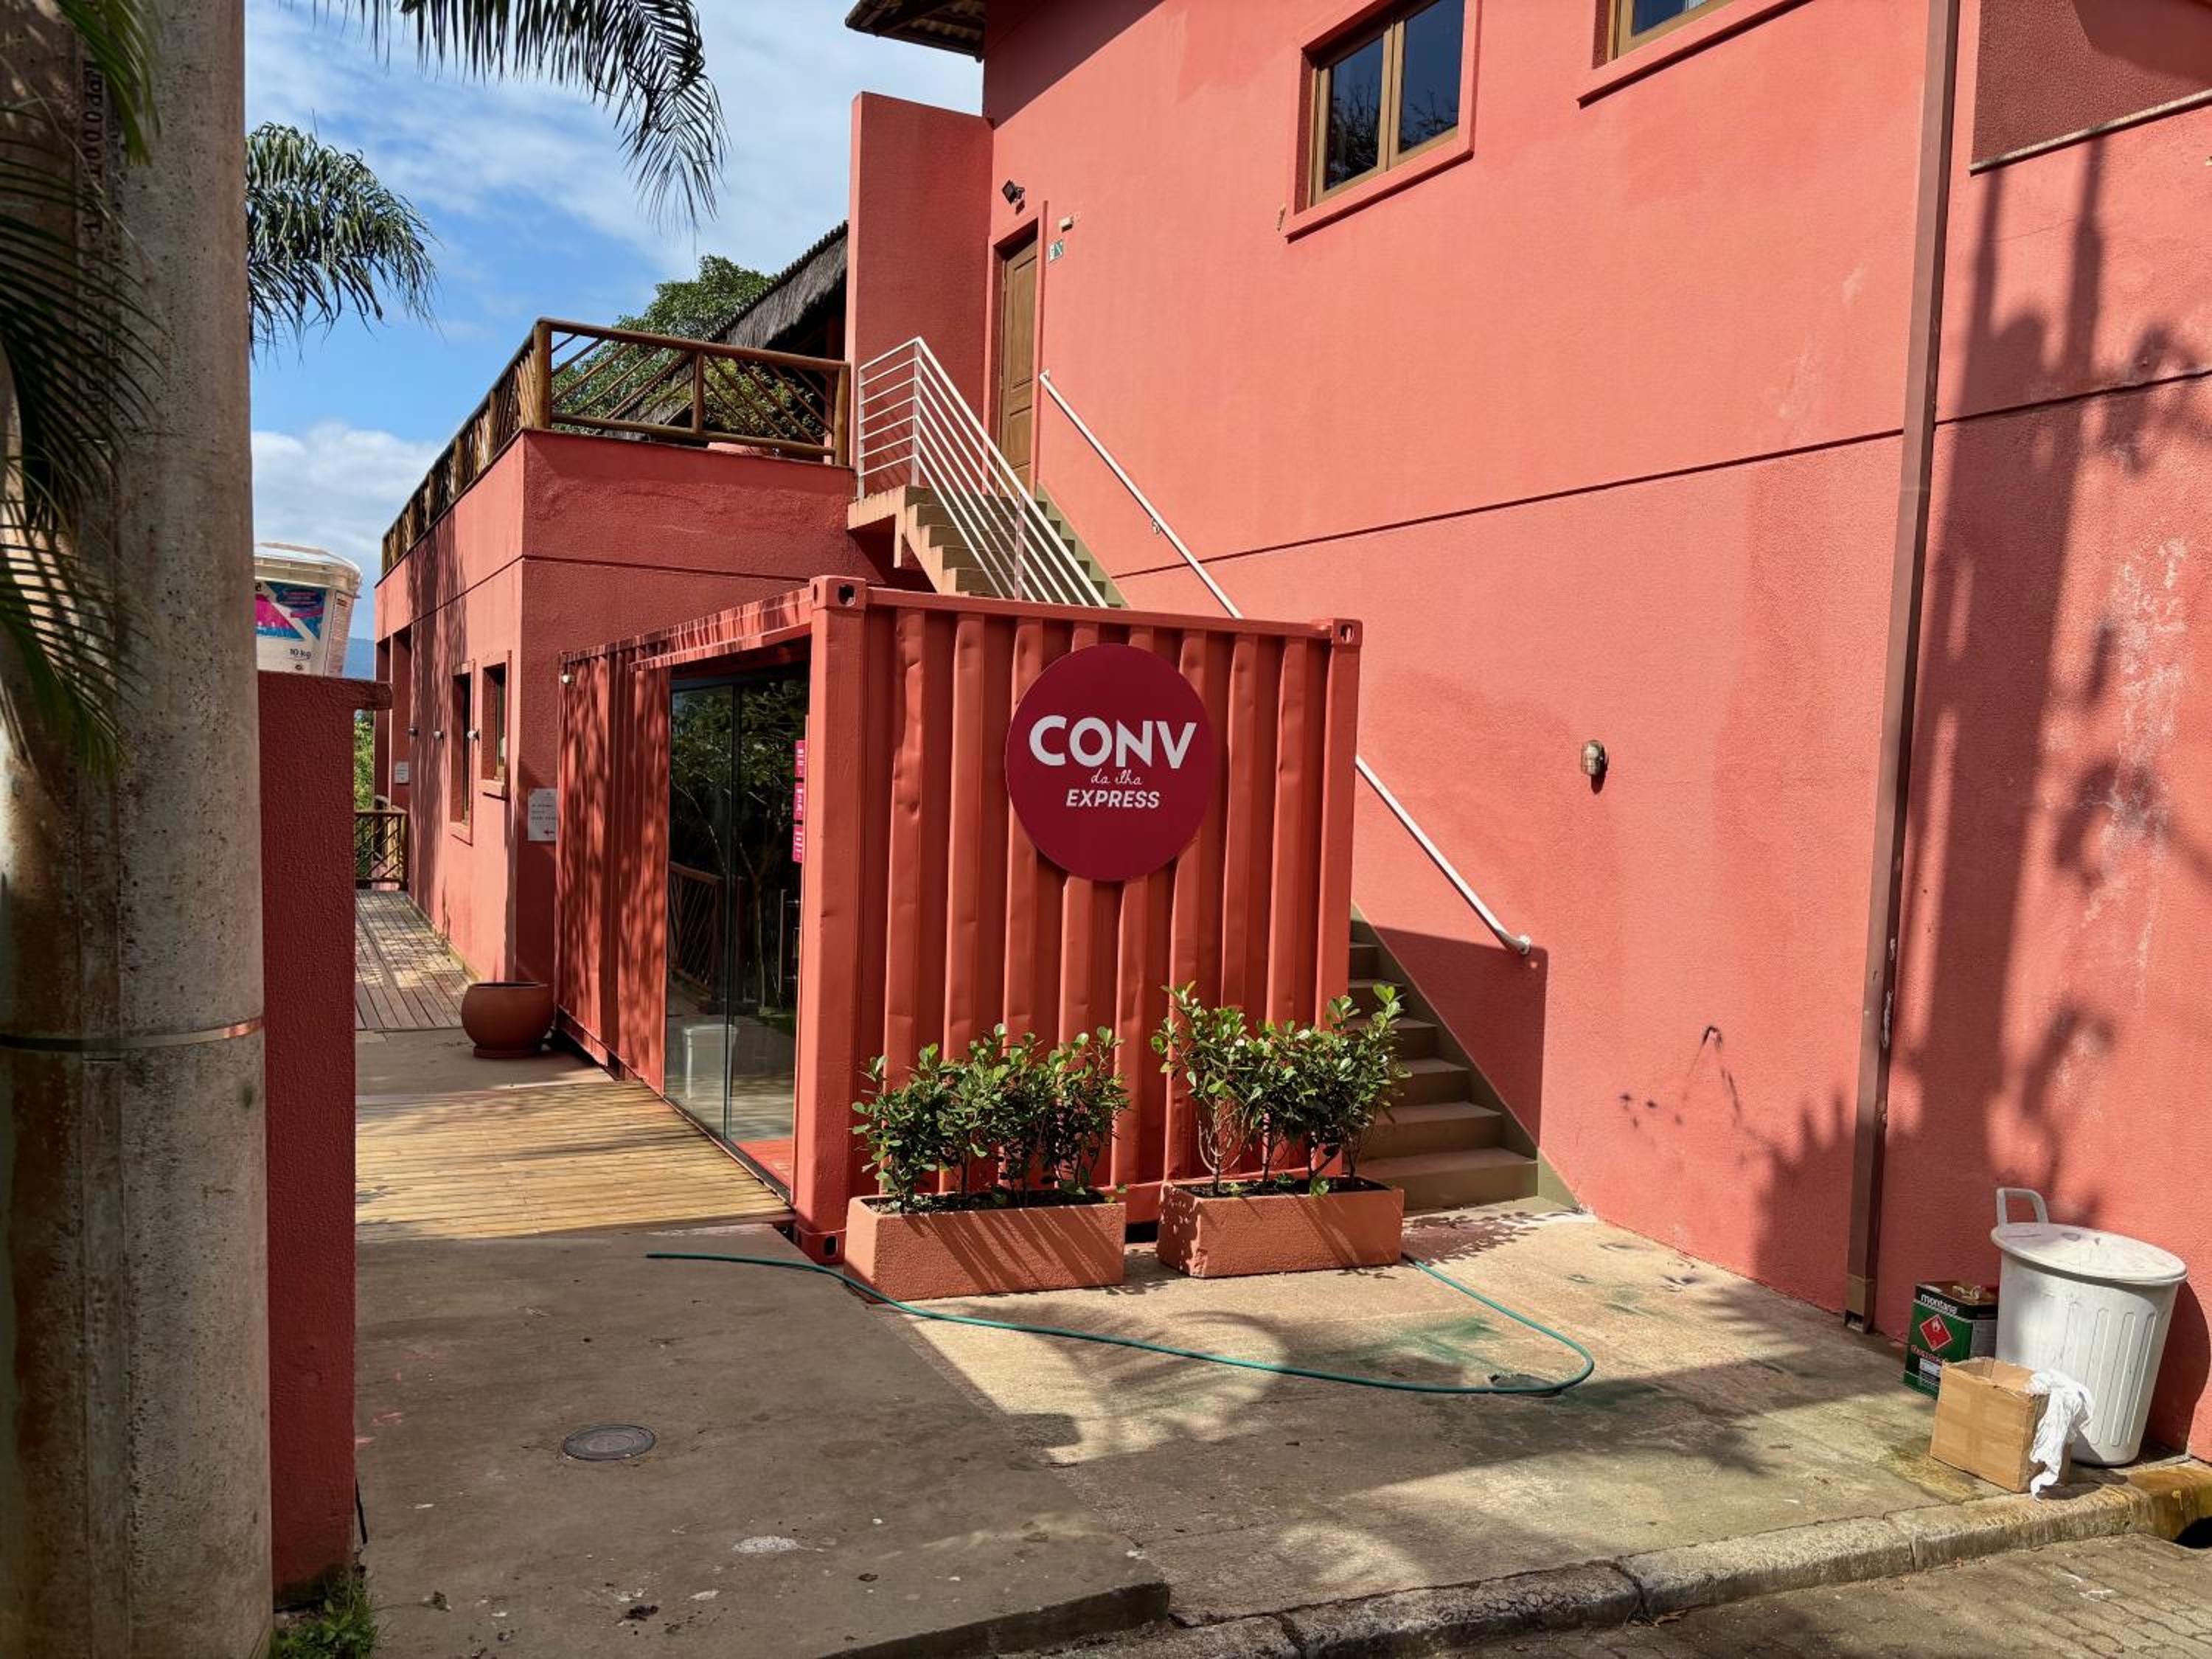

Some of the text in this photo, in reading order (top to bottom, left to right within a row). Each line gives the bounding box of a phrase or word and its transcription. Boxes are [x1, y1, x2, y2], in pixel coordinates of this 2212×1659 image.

[1029, 715, 1197, 769] CONV
[1091, 768, 1143, 785] da ilha
[1066, 789, 1160, 808] EXPRESS
